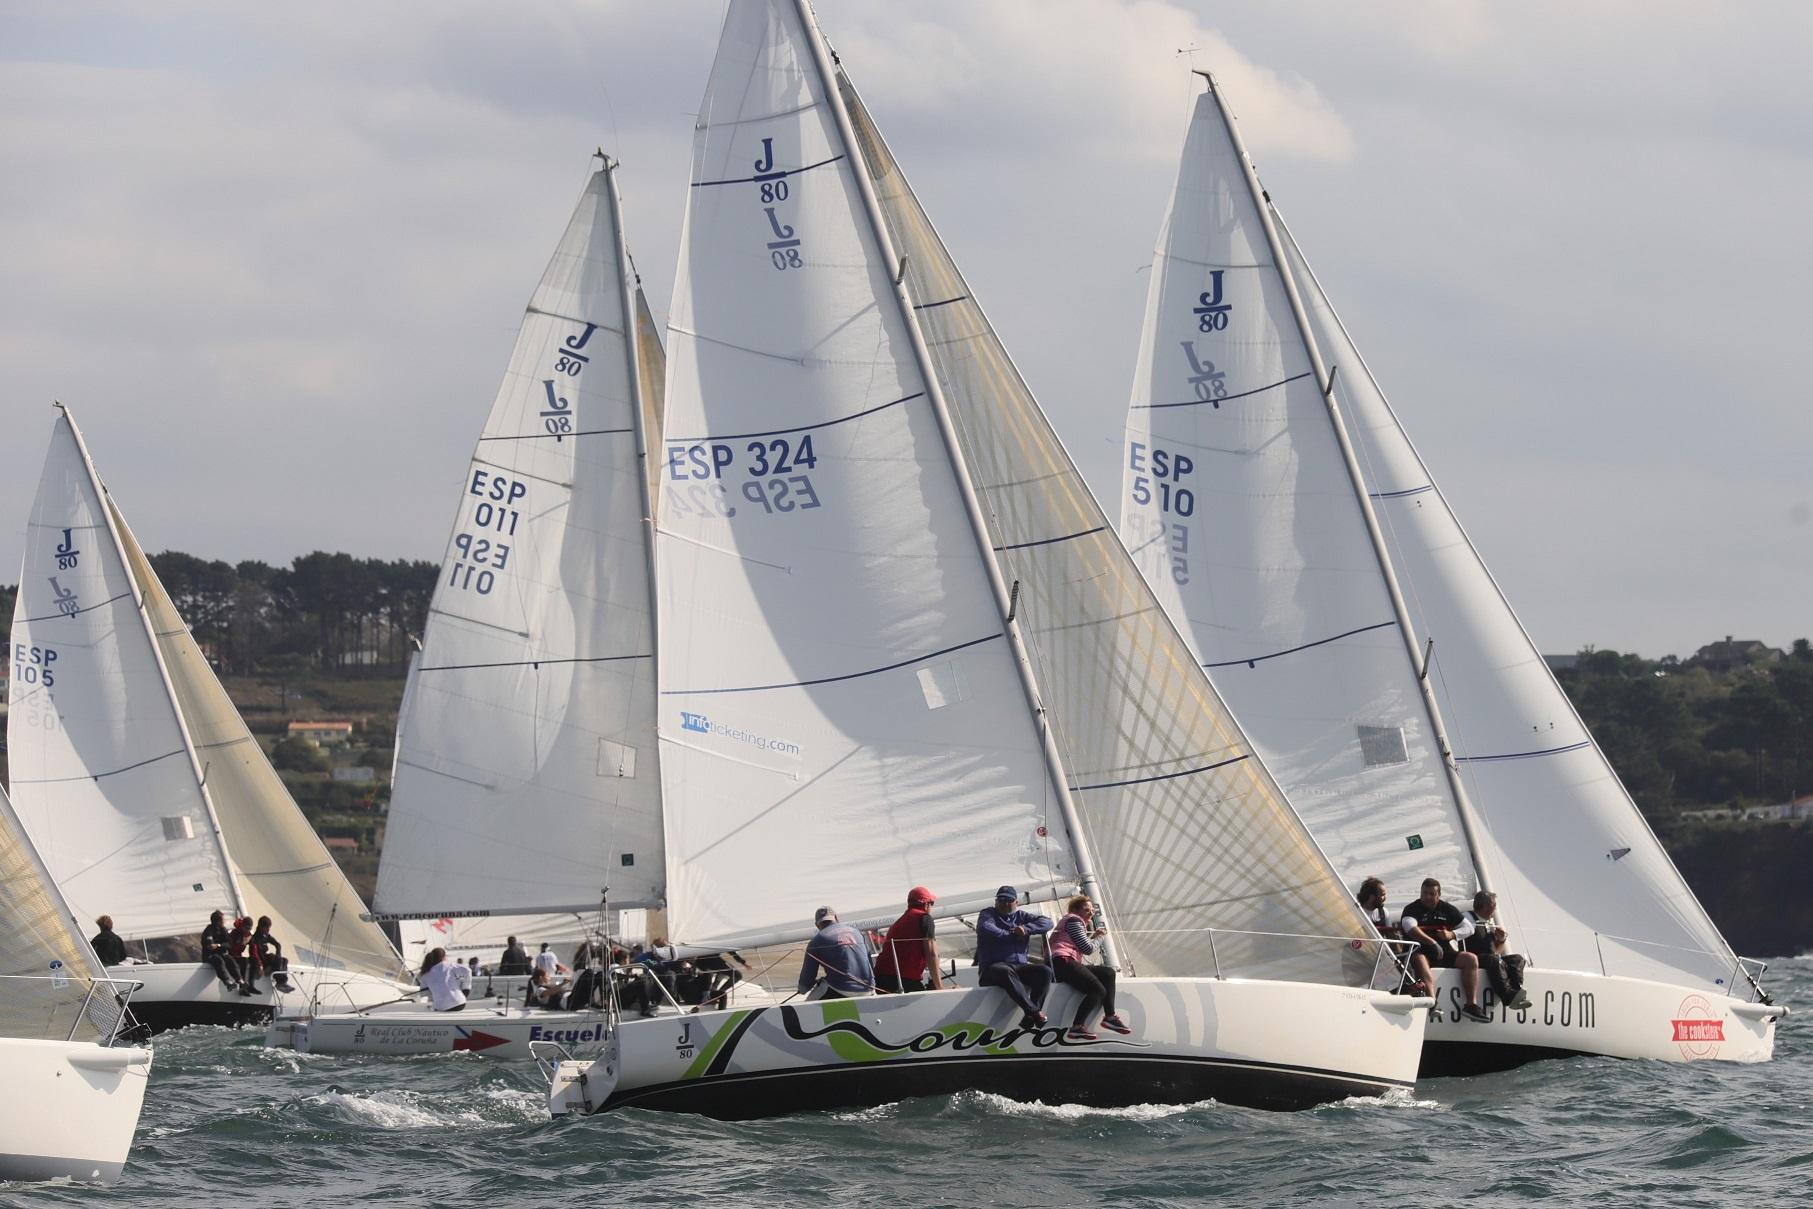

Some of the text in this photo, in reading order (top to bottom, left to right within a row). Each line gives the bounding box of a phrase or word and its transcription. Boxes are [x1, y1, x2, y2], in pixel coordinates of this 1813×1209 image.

[755, 137, 773, 173] J
[760, 180, 789, 204] 80
[1199, 270, 1225, 306] J
[1200, 312, 1229, 333] 80
[566, 322, 598, 350] J
[554, 356, 582, 377] 80
[668, 434, 817, 481] ESP 324
[1130, 441, 1194, 482] ESP
[470, 470, 527, 505] ESP
[1132, 476, 1194, 517] 510
[475, 502, 519, 537] 011
[57, 528, 73, 553] J
[58, 557, 78, 571] 80
[15, 644, 58, 668] ESP
[15, 664, 55, 688] 105
[356, 1023, 365, 1035] J
[380, 1036, 389, 1044] de
[391, 1026, 411, 1037] Club
[678, 1022, 690, 1044] J
[680, 1049, 693, 1059] 80
